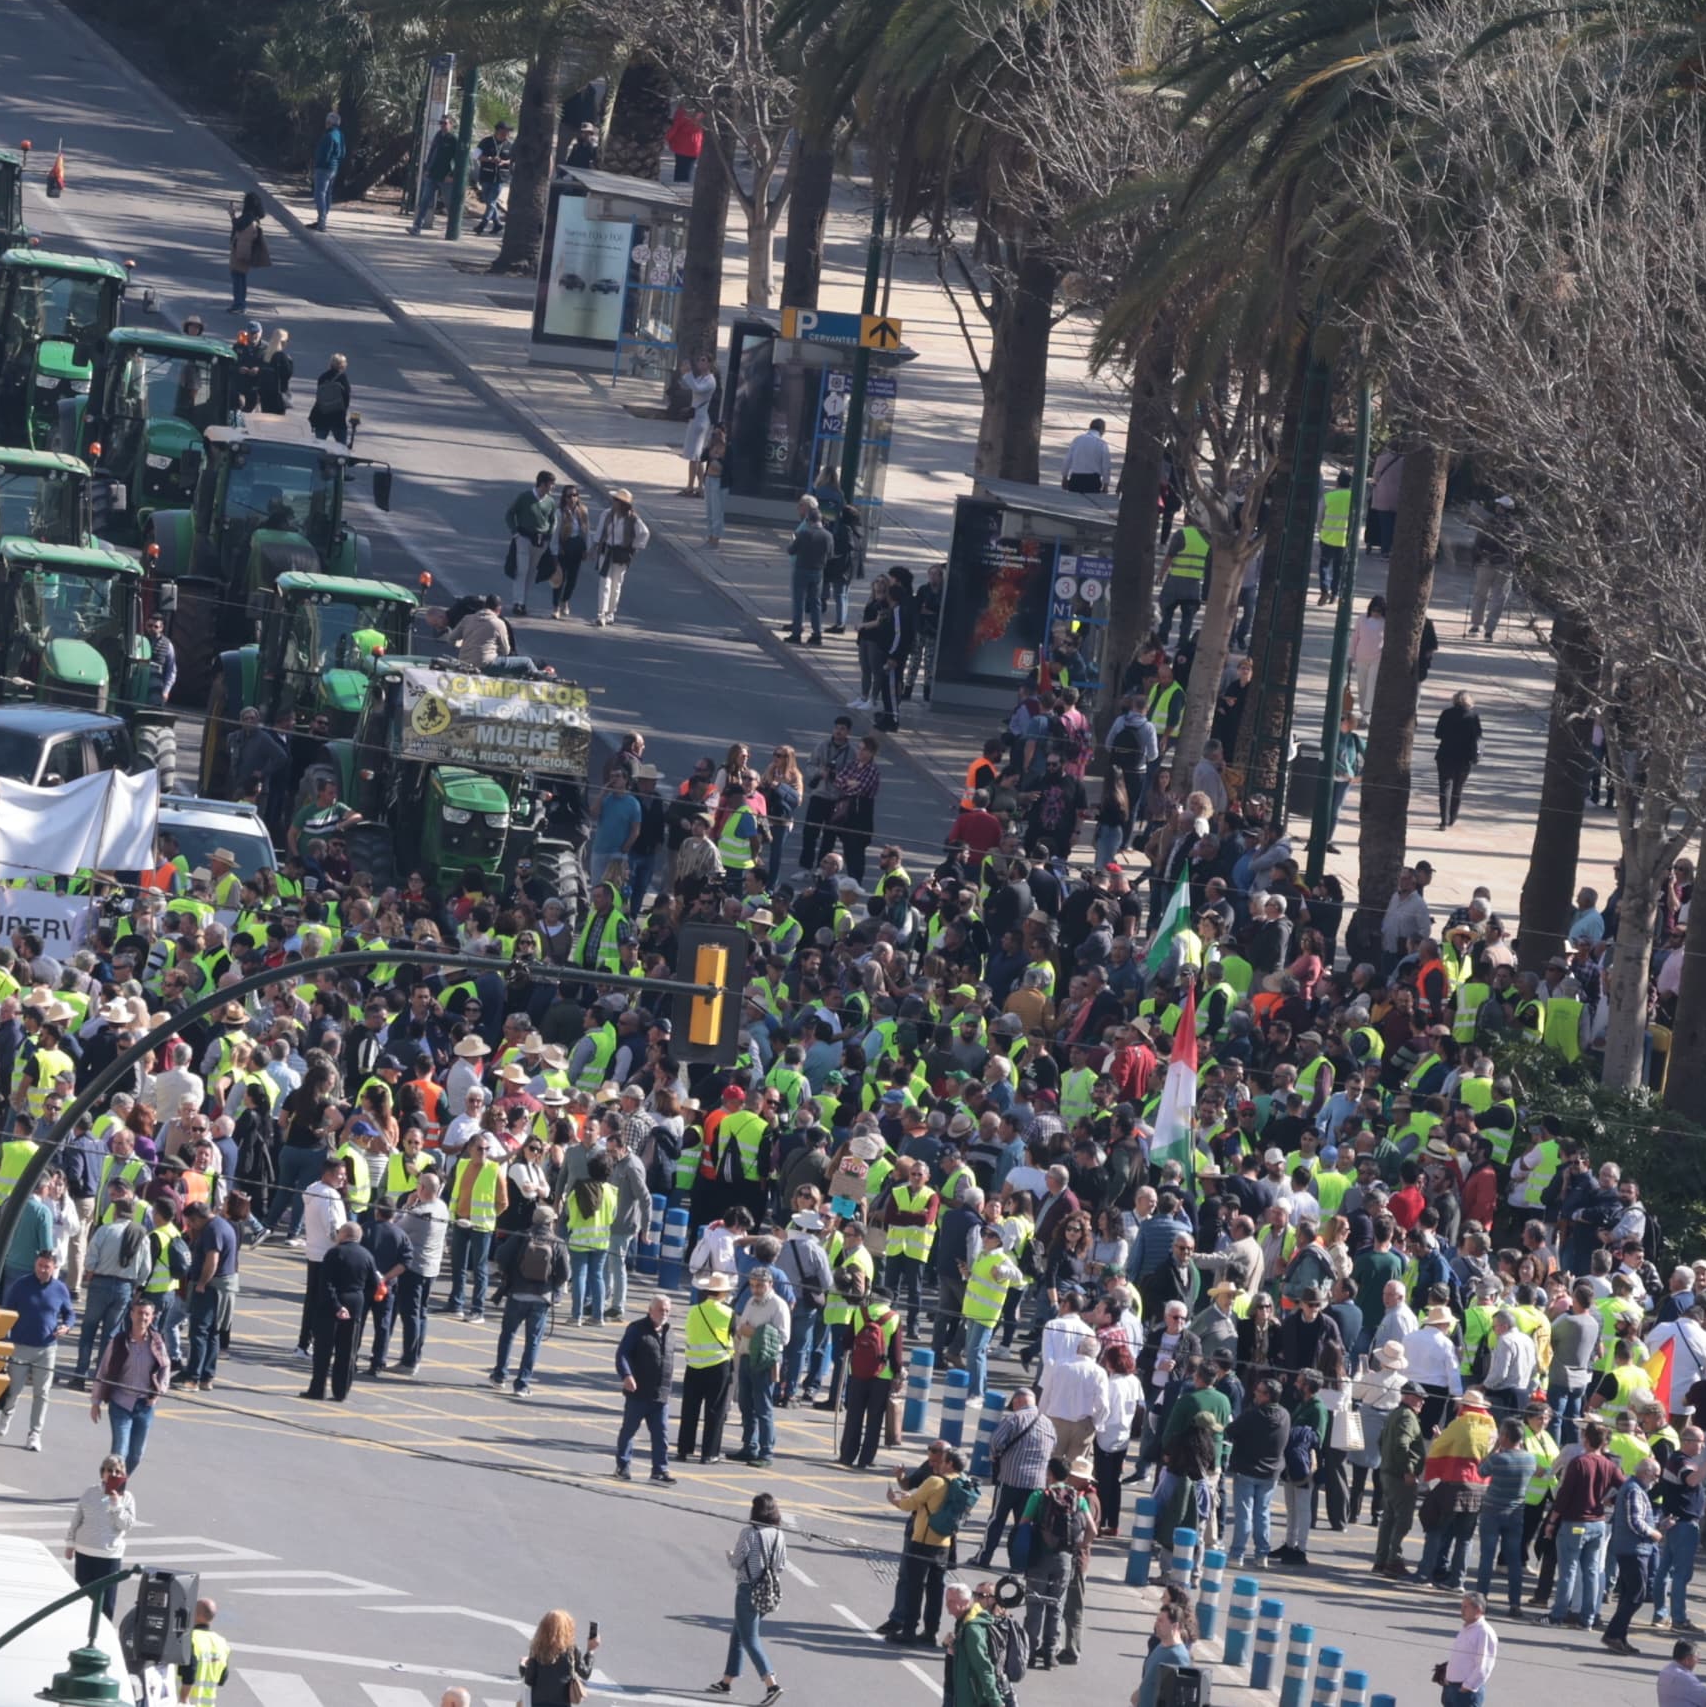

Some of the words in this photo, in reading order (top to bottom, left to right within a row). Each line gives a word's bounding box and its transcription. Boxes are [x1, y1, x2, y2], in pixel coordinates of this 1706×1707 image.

[796, 309, 818, 339] P
[808, 333, 859, 345] CERVANTES
[869, 402, 888, 415] C2
[822, 419, 841, 432] N2
[1061, 581, 1070, 594] 3
[1053, 602, 1073, 618] N1
[451, 676, 588, 708] CAMPILLOS
[459, 699, 487, 718] EL
[476, 725, 561, 751] MUERE
[451, 748, 478, 762] PAC,
[479, 751, 518, 766] RIEGO,
[841, 1160, 868, 1177] STOP
